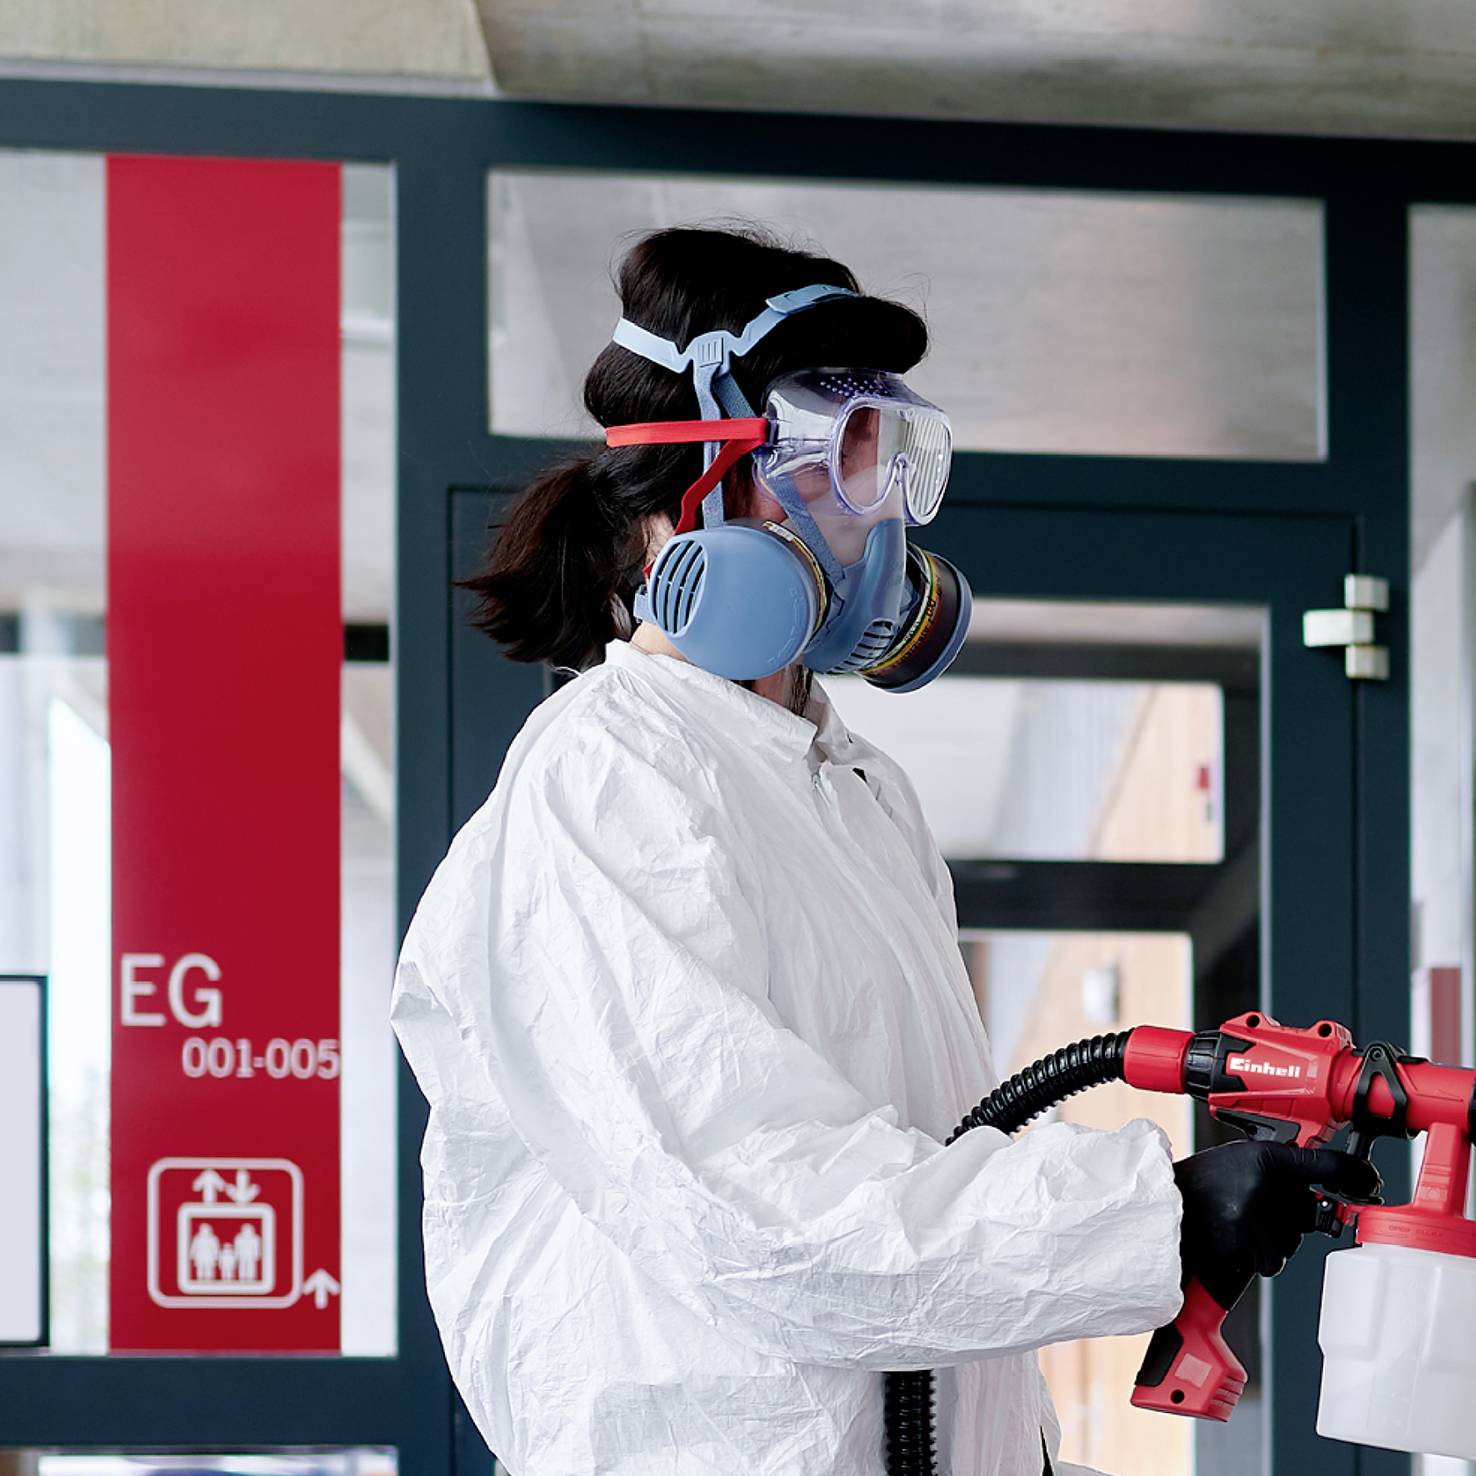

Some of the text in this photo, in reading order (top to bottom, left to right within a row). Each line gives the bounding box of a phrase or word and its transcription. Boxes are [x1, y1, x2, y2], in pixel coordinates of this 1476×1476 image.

[120, 953, 223, 1028] EG
[181, 1037, 340, 1079] 001-005
[1230, 1057, 1301, 1078] Einhell
